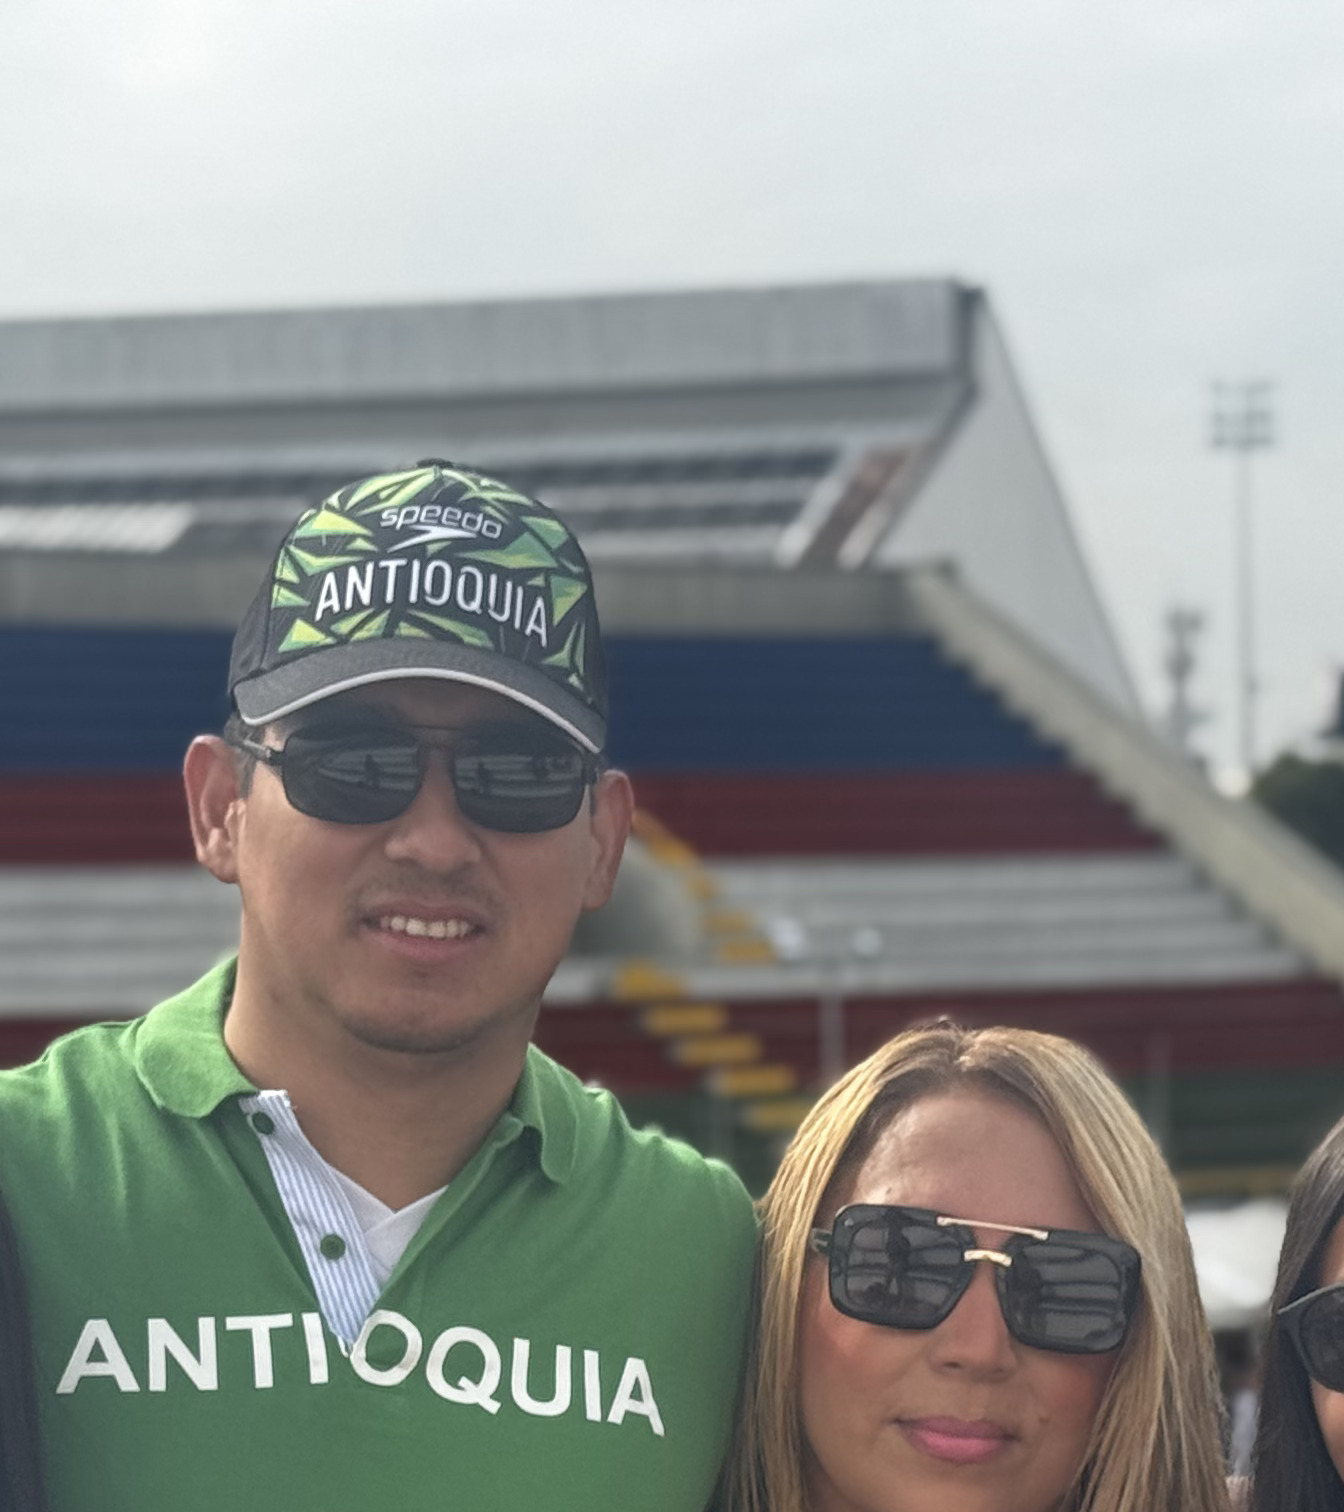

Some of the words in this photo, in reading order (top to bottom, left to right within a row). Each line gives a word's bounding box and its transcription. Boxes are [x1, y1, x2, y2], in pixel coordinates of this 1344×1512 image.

[380, 505, 503, 540] speedo
[314, 558, 549, 649] ANTIOQUIA
[56, 1310, 665, 1436] ANTIOQUIA
